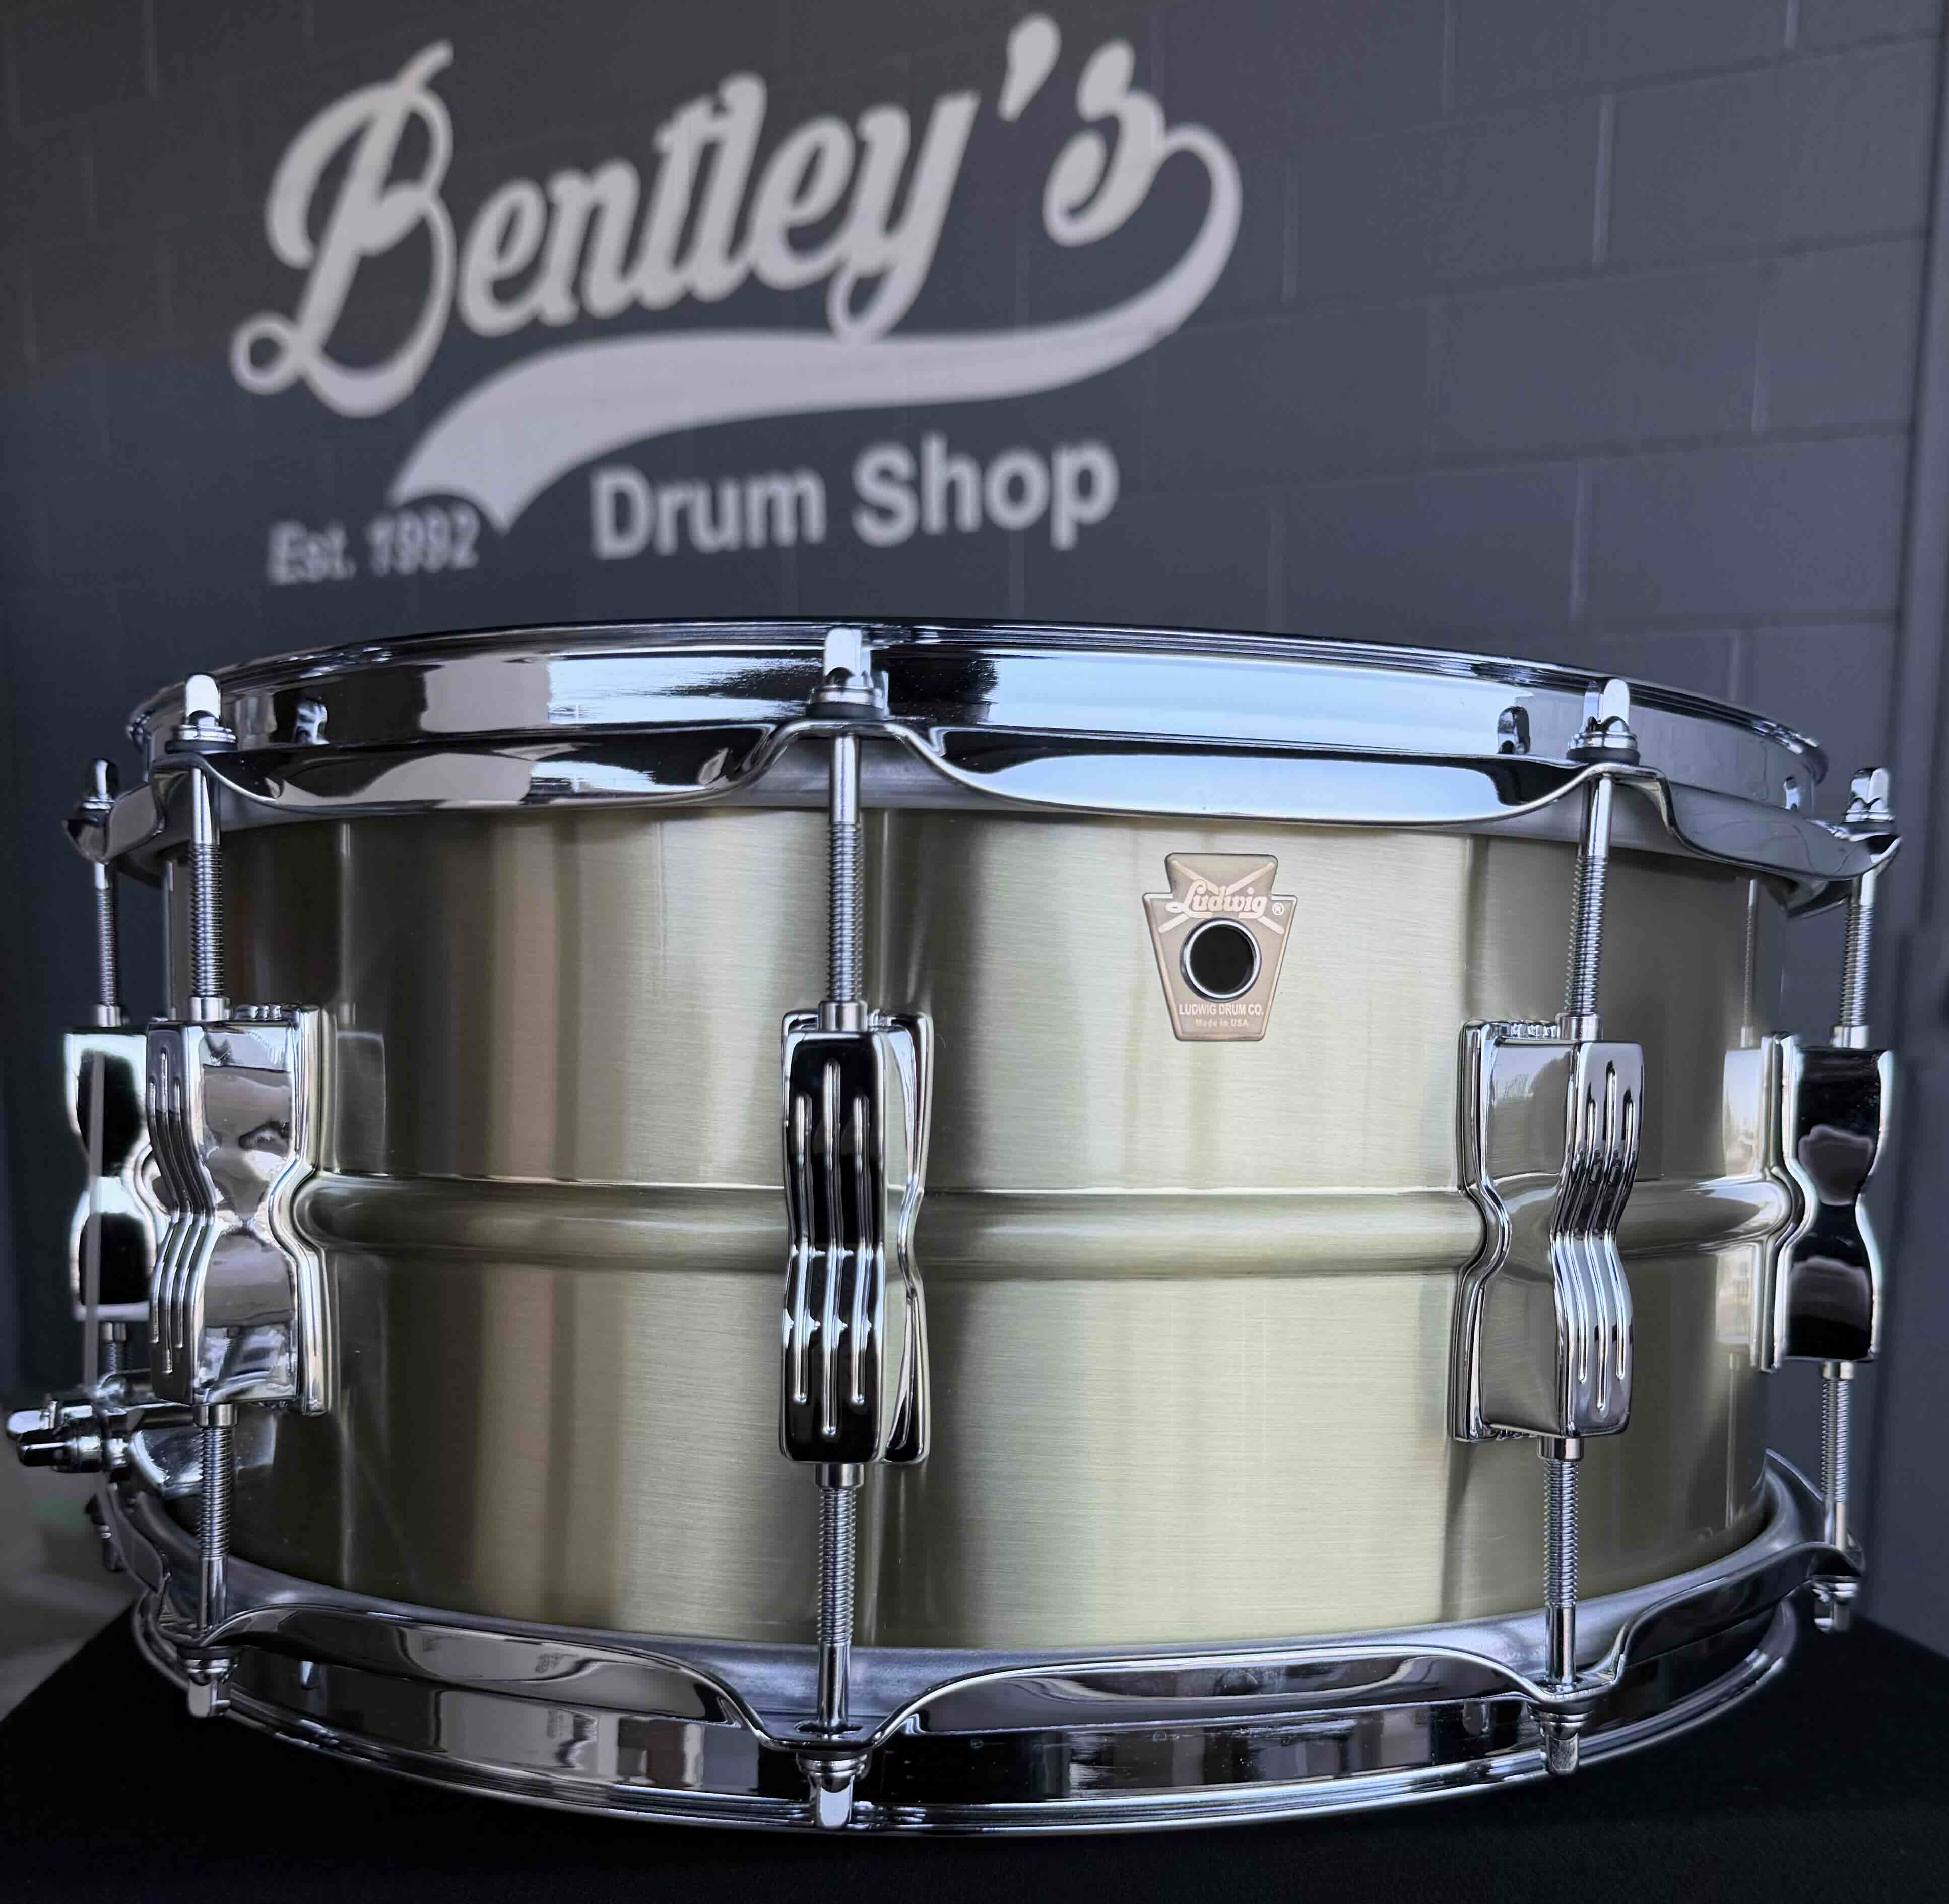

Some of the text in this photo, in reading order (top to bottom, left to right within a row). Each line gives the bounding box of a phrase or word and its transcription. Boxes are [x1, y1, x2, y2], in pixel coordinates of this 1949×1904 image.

[231, 13, 1168, 417] Bentley's
[592, 431, 1120, 560] Drum Shop
[268, 506, 480, 585] Est. 1992
[1165, 879, 1267, 919] Ludwig
[1179, 1003, 1264, 1016] LUDWIG DRUM CO.
[1231, 1019, 1249, 1027] USA
